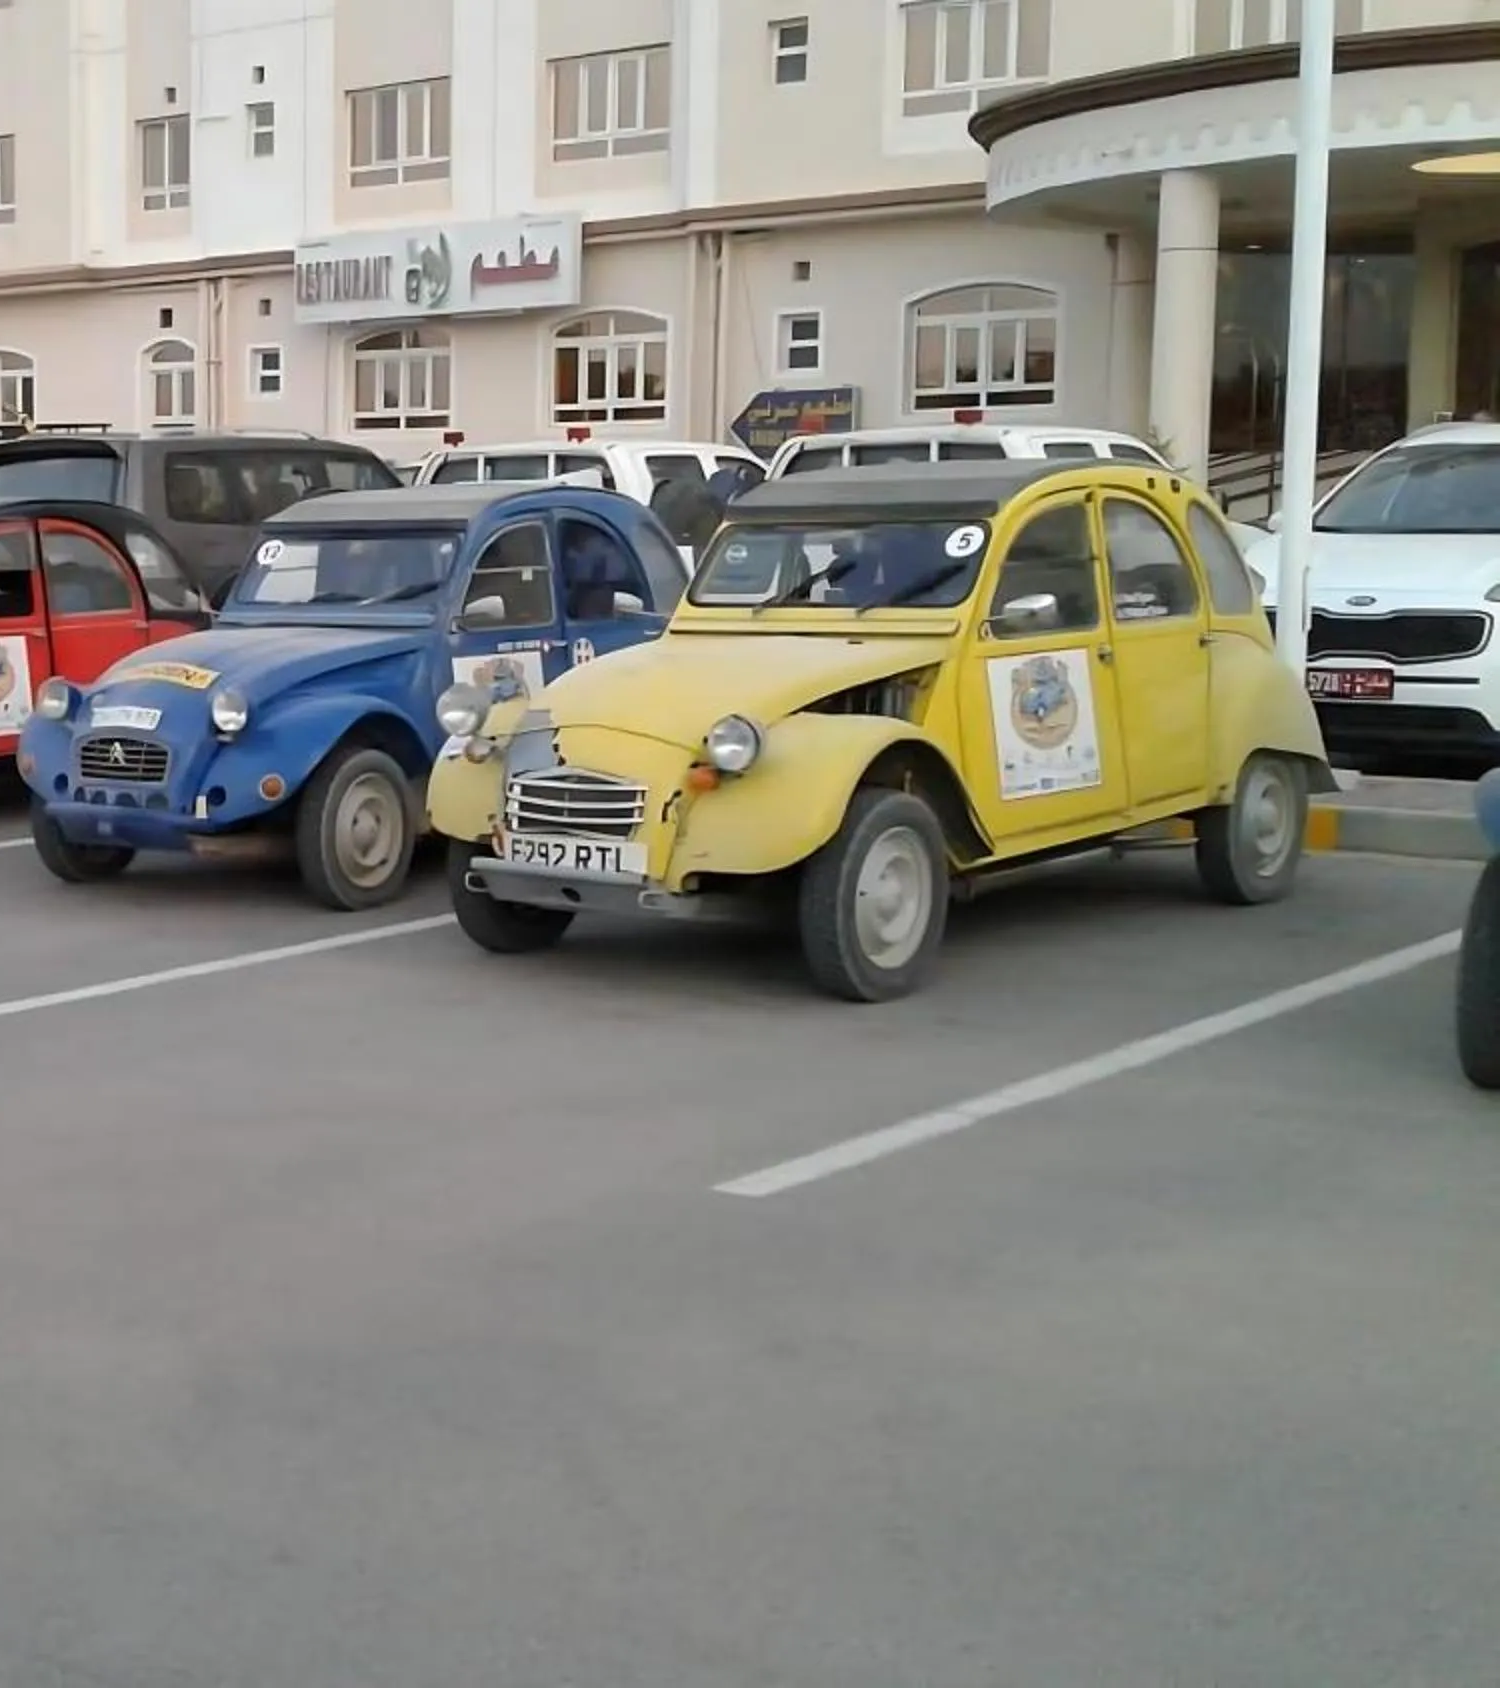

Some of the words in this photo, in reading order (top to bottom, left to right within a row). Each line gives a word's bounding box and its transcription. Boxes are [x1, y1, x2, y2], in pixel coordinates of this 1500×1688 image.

[296, 254, 393, 305] RESTAURANT
[470, 232, 560, 301] مطعم
[956, 533, 974, 550] 5
